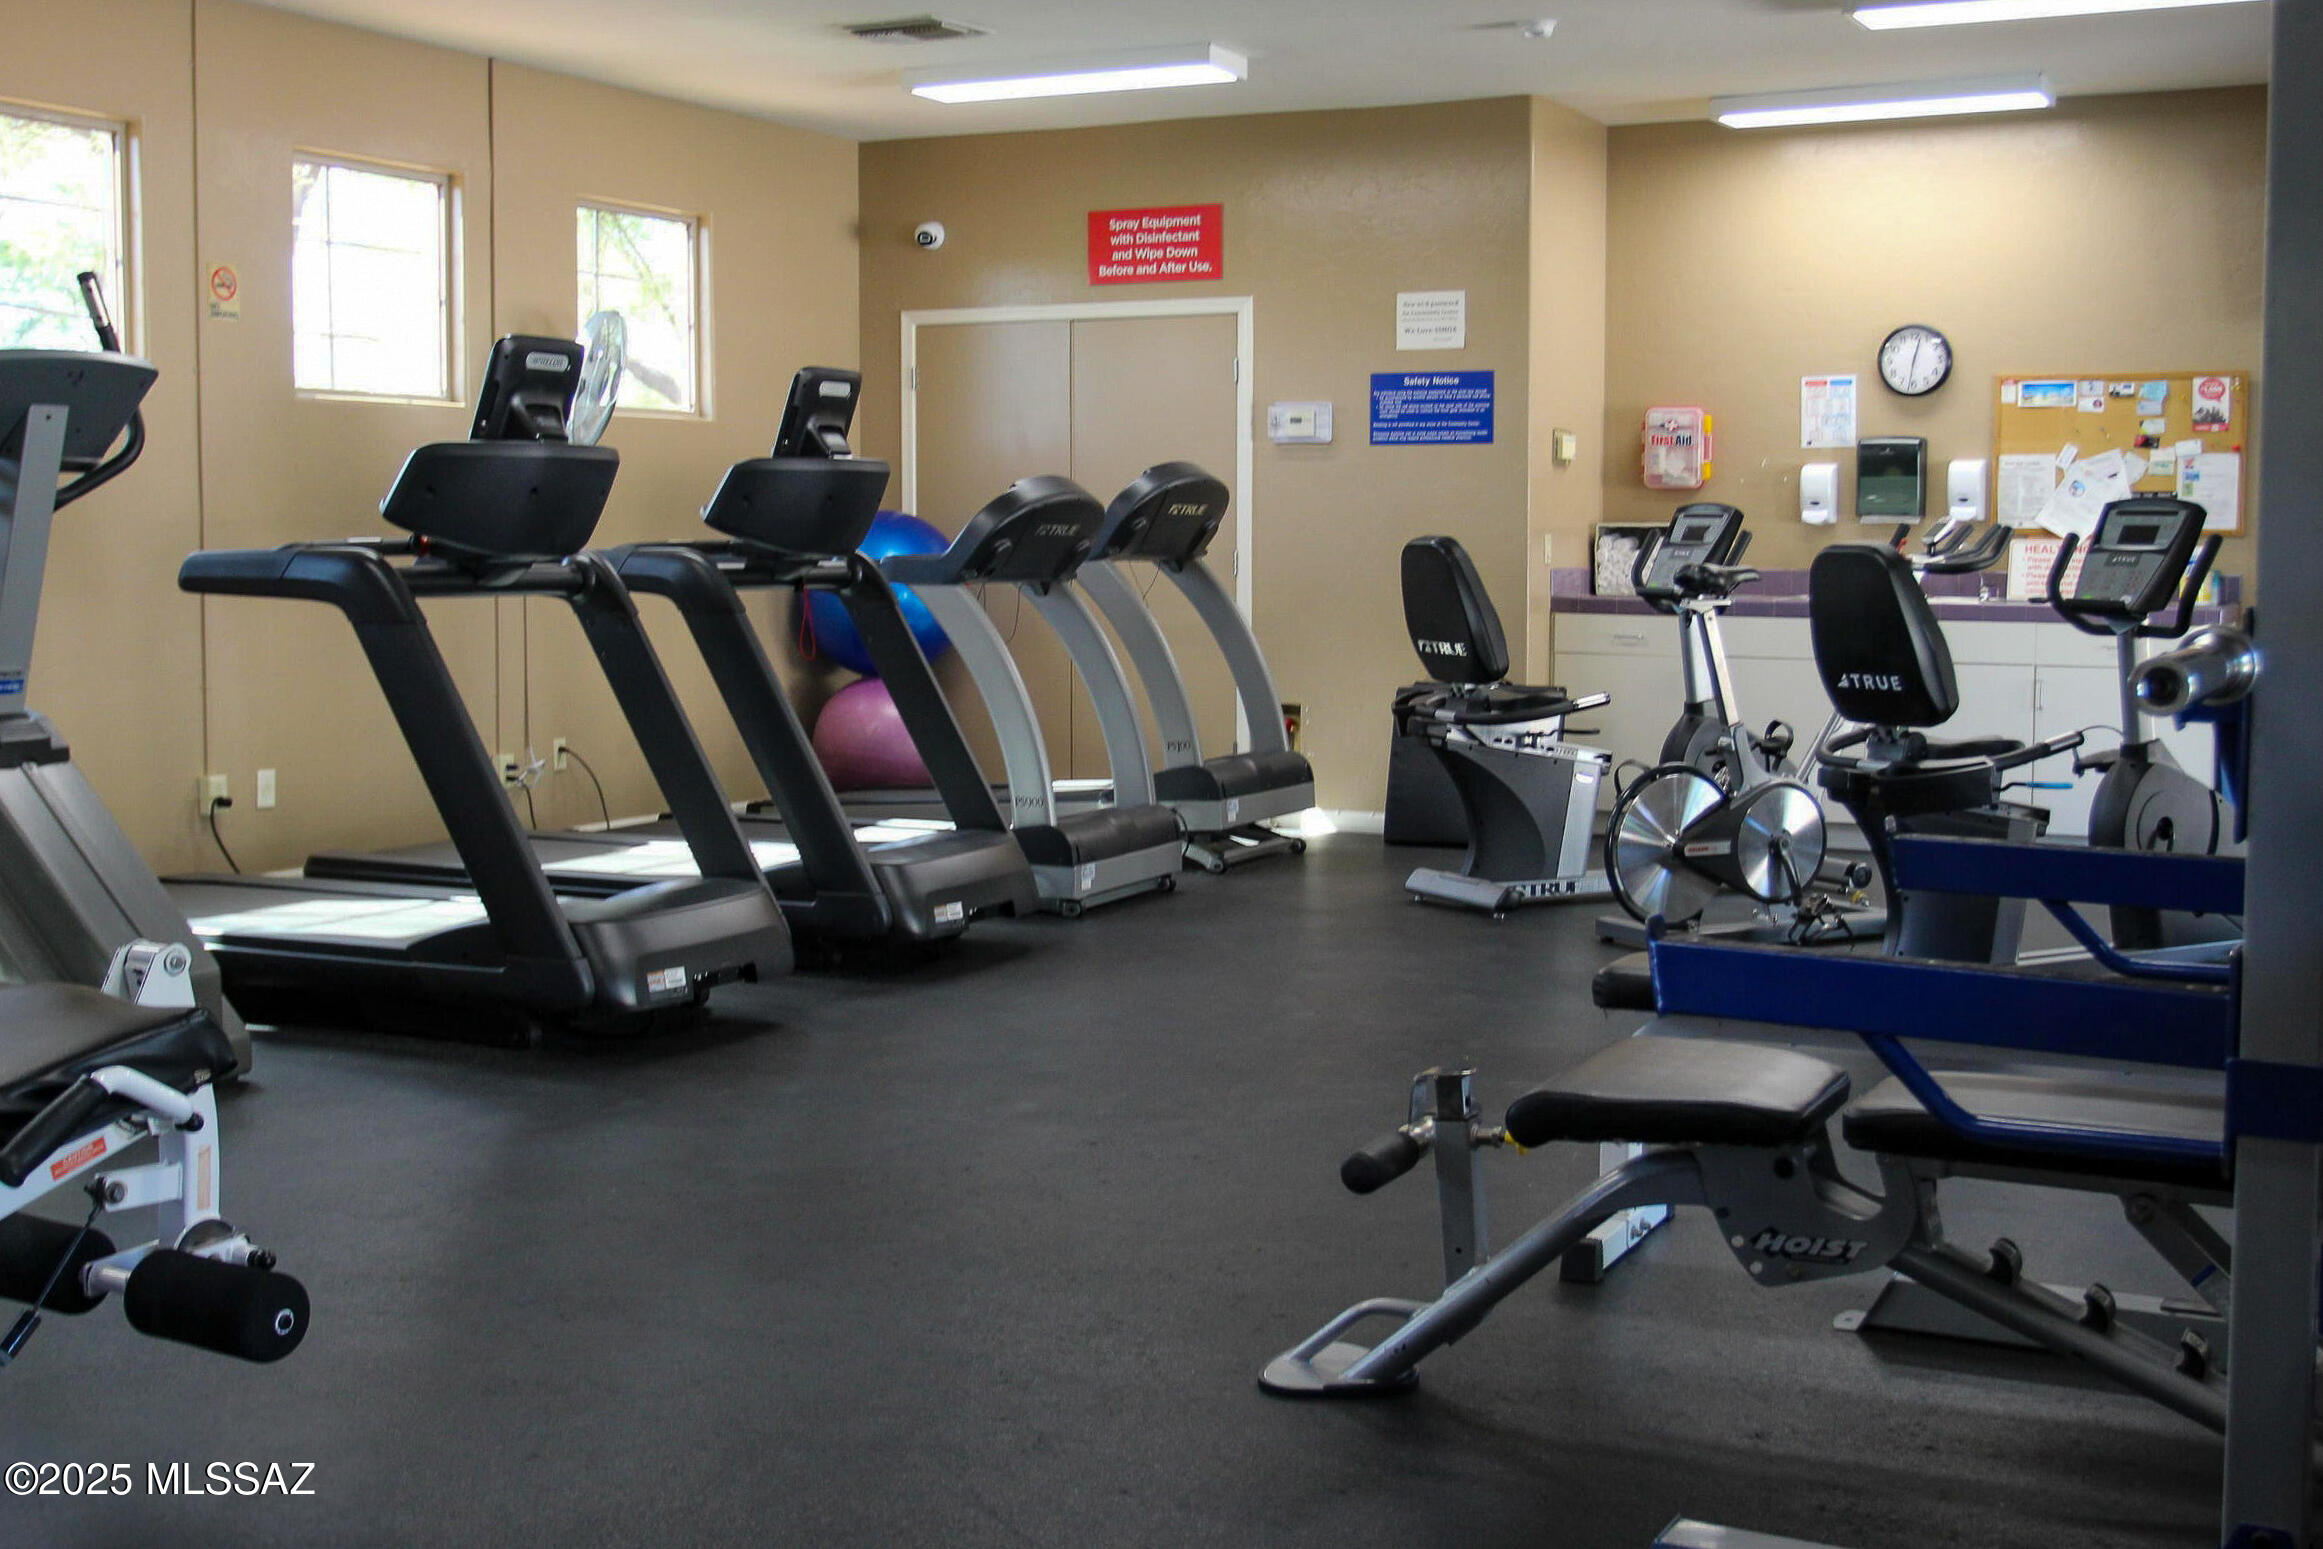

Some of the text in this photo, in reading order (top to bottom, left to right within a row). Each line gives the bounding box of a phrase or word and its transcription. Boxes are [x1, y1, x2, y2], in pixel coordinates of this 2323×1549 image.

[1109, 214, 1201, 232] Spray Equipment
[1110, 230, 1200, 246] with Disinfectant
[1112, 246, 1198, 262] and Wipe Down
[1098, 260, 1213, 277] Before and After Use.
[1403, 375, 1460, 387] Safety Notice
[1651, 434, 1692, 446] First Aid
[1431, 641, 1468, 656] TRUE
[1850, 673, 1902, 691] TRUE
[1754, 1231, 1868, 1259] HOIST
